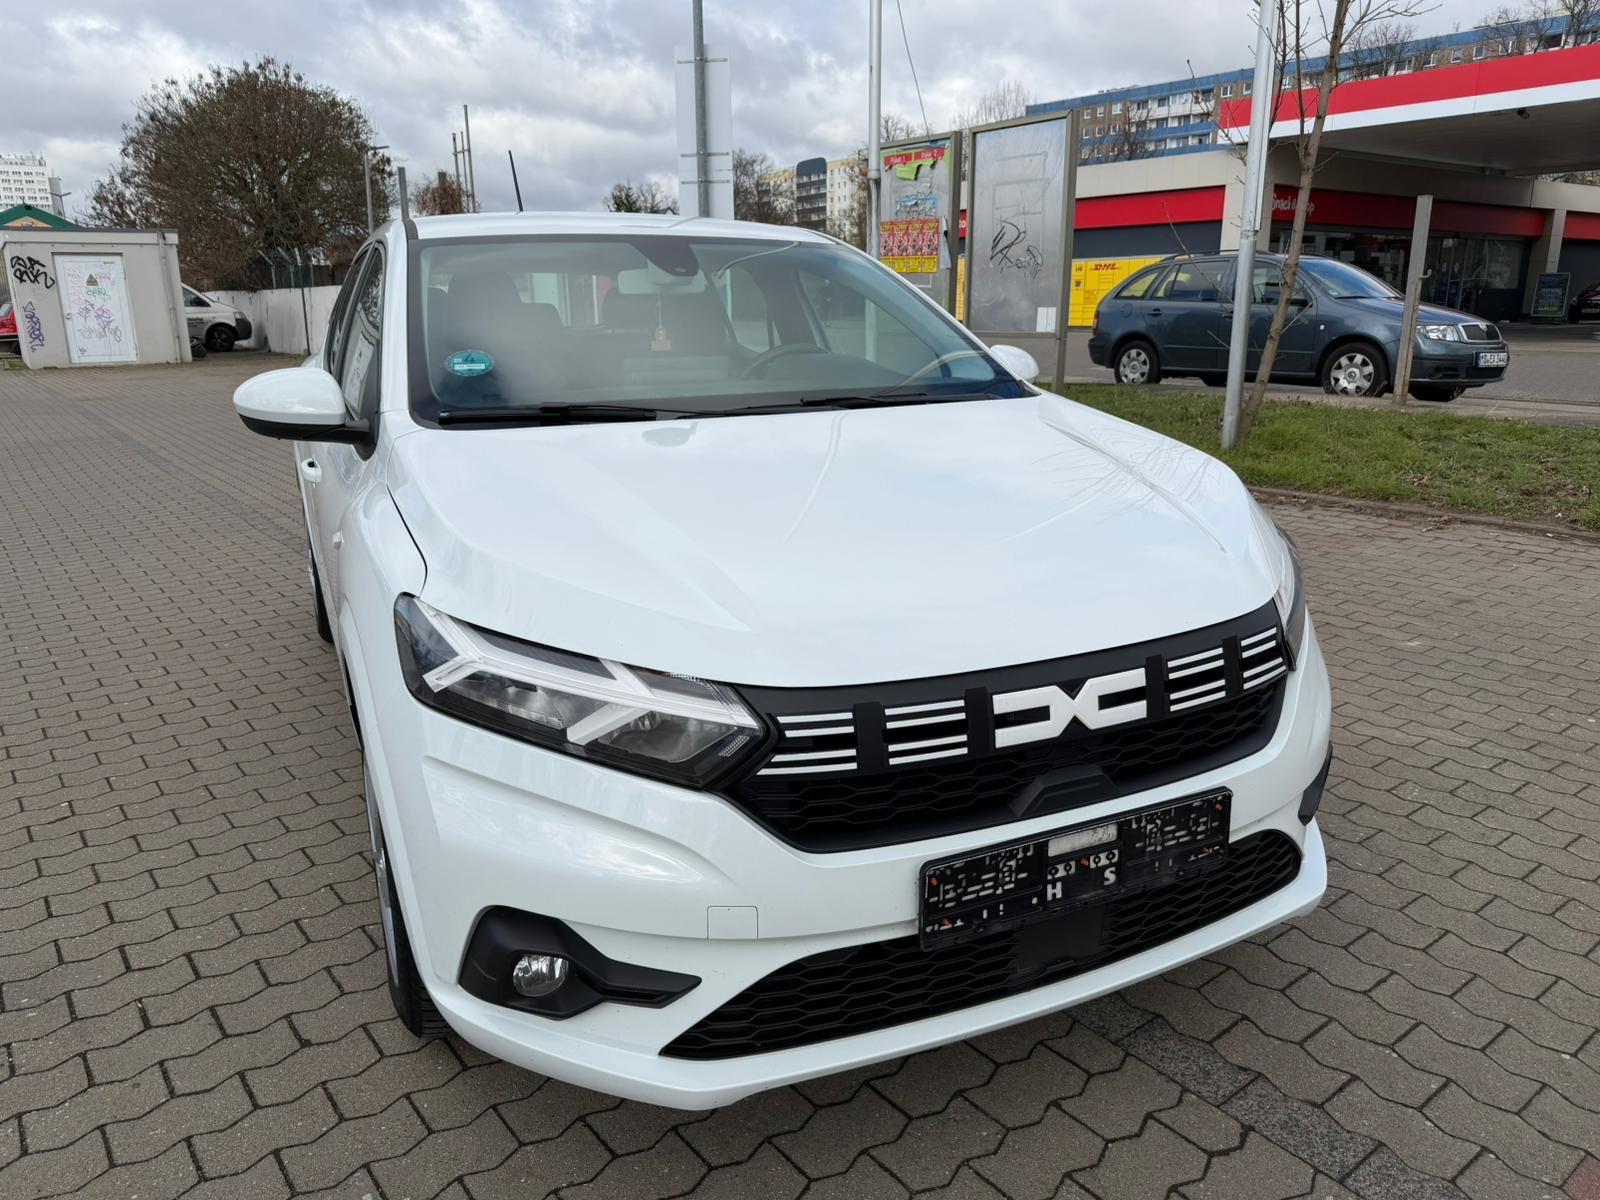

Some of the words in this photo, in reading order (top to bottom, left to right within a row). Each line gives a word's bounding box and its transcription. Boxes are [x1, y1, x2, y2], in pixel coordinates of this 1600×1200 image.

[1094, 263, 1116, 271] DHL
[1046, 881, 1063, 901] H
[1103, 866, 1117, 886] S
